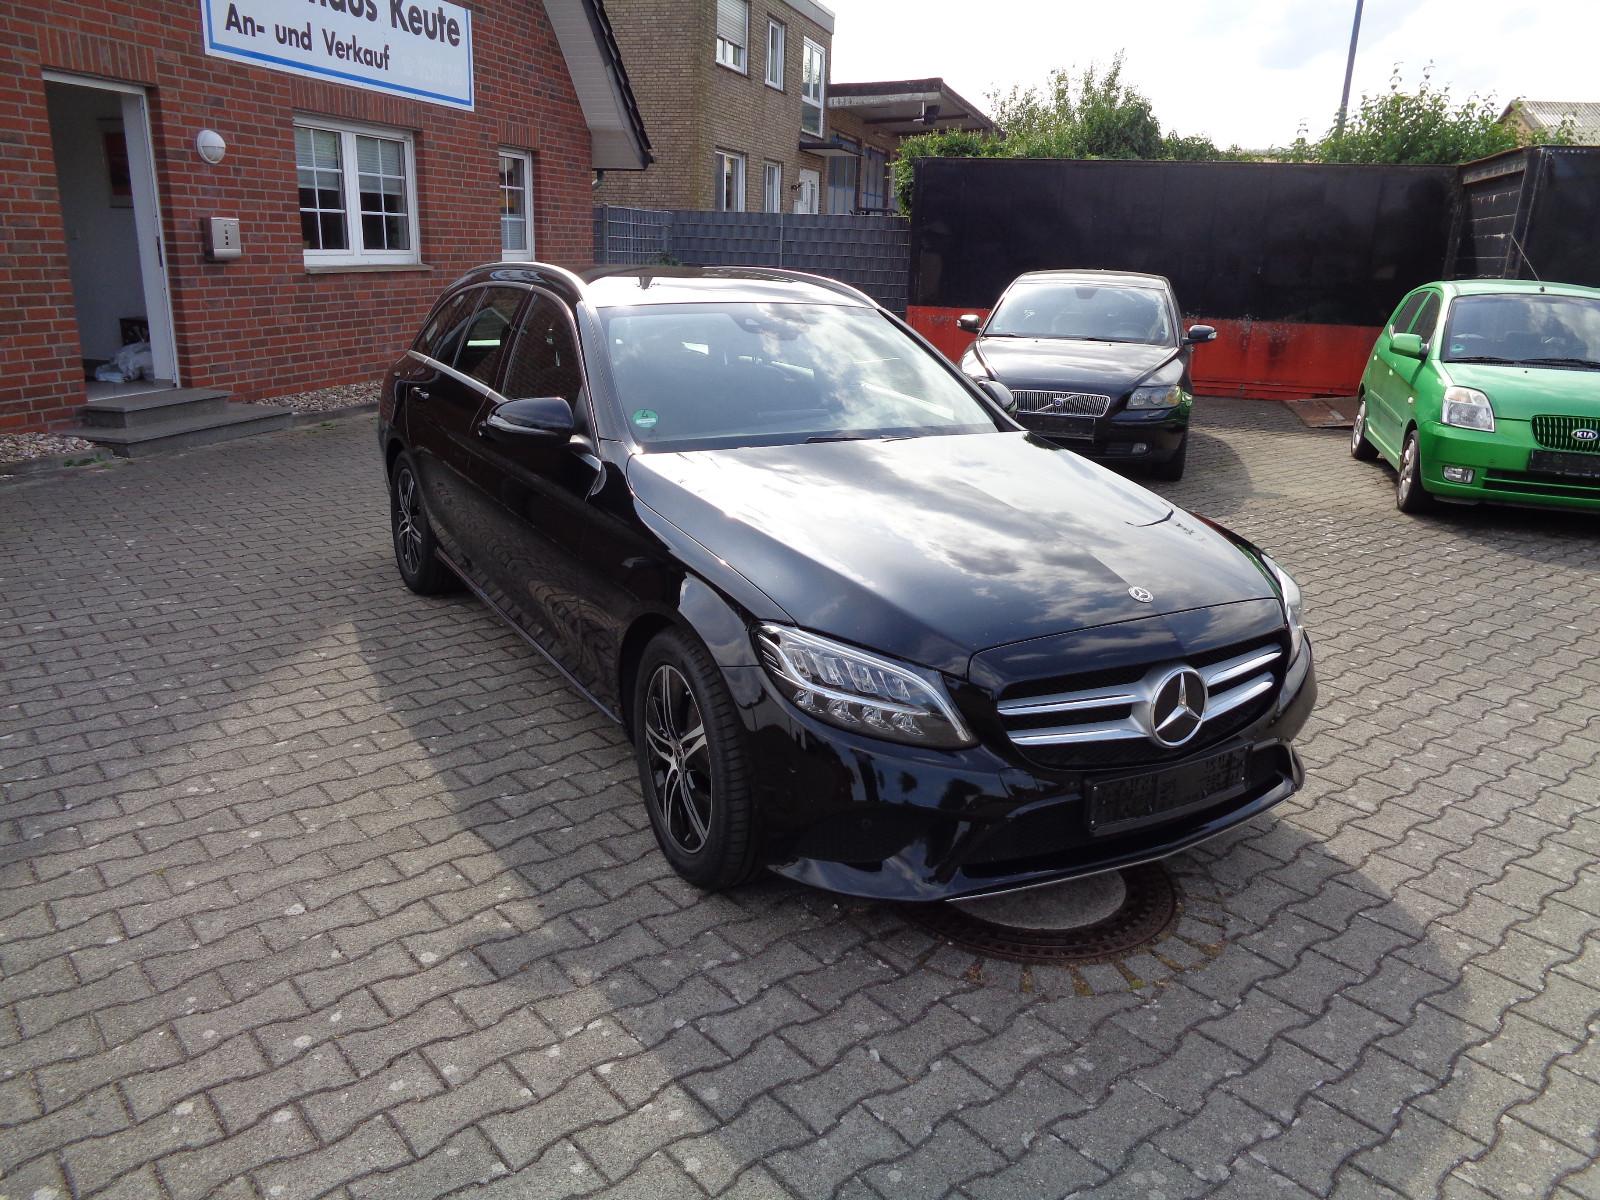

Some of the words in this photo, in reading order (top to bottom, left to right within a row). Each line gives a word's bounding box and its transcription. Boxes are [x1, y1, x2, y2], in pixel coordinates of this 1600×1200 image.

[225, 3, 265, 37] An-
[274, 22, 312, 51] und
[322, 28, 390, 70] Verkauf
[390, 0, 461, 47] Keute
